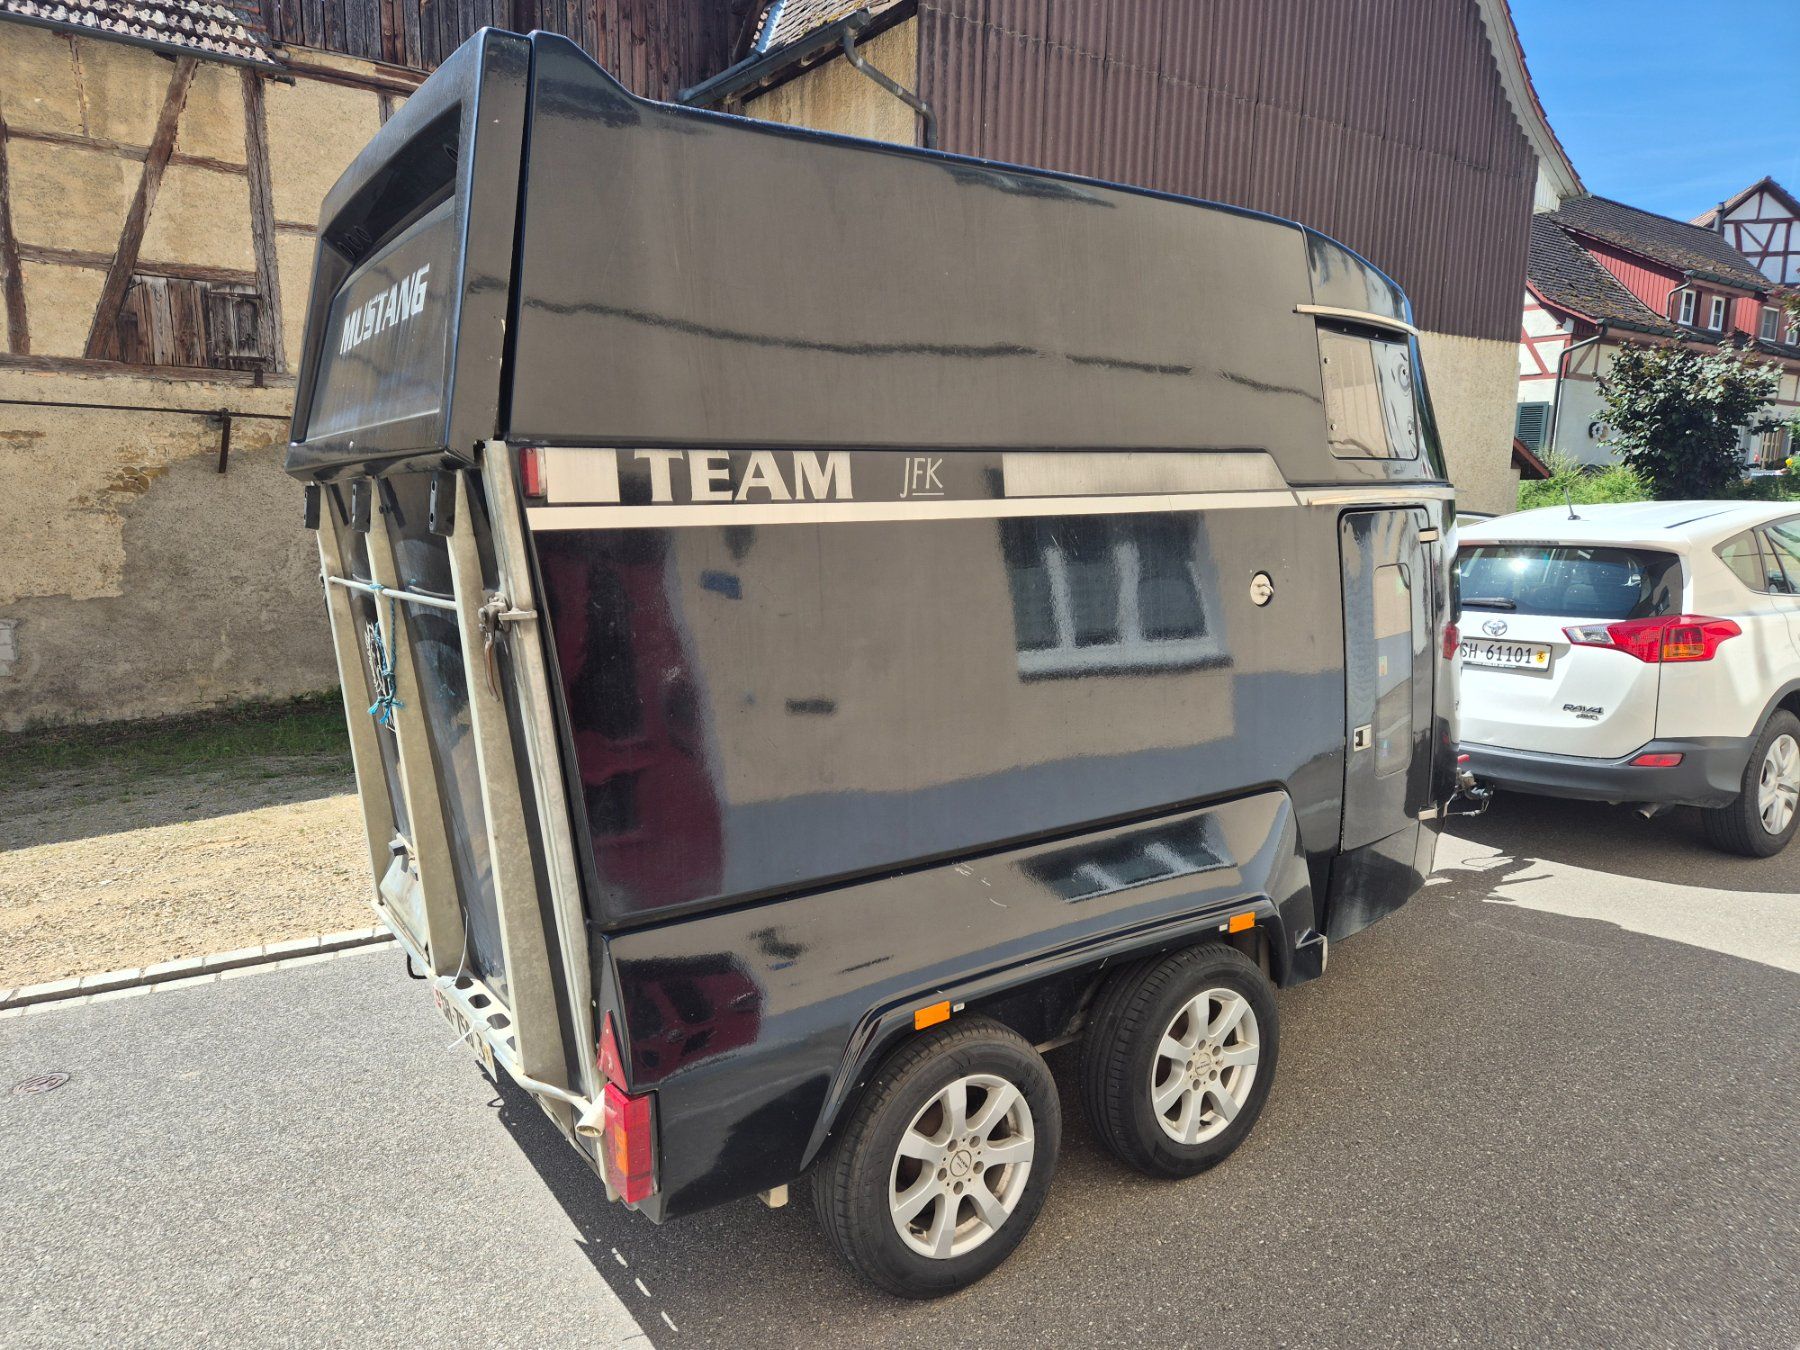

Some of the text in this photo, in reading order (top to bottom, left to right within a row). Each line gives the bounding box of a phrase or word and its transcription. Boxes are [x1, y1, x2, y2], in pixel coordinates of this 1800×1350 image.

[339, 262, 431, 356] MUSTANG
[634, 449, 944, 502] TEAM JFK
[1486, 644, 1532, 664] 61101
[1562, 703, 1604, 715] RAV4
